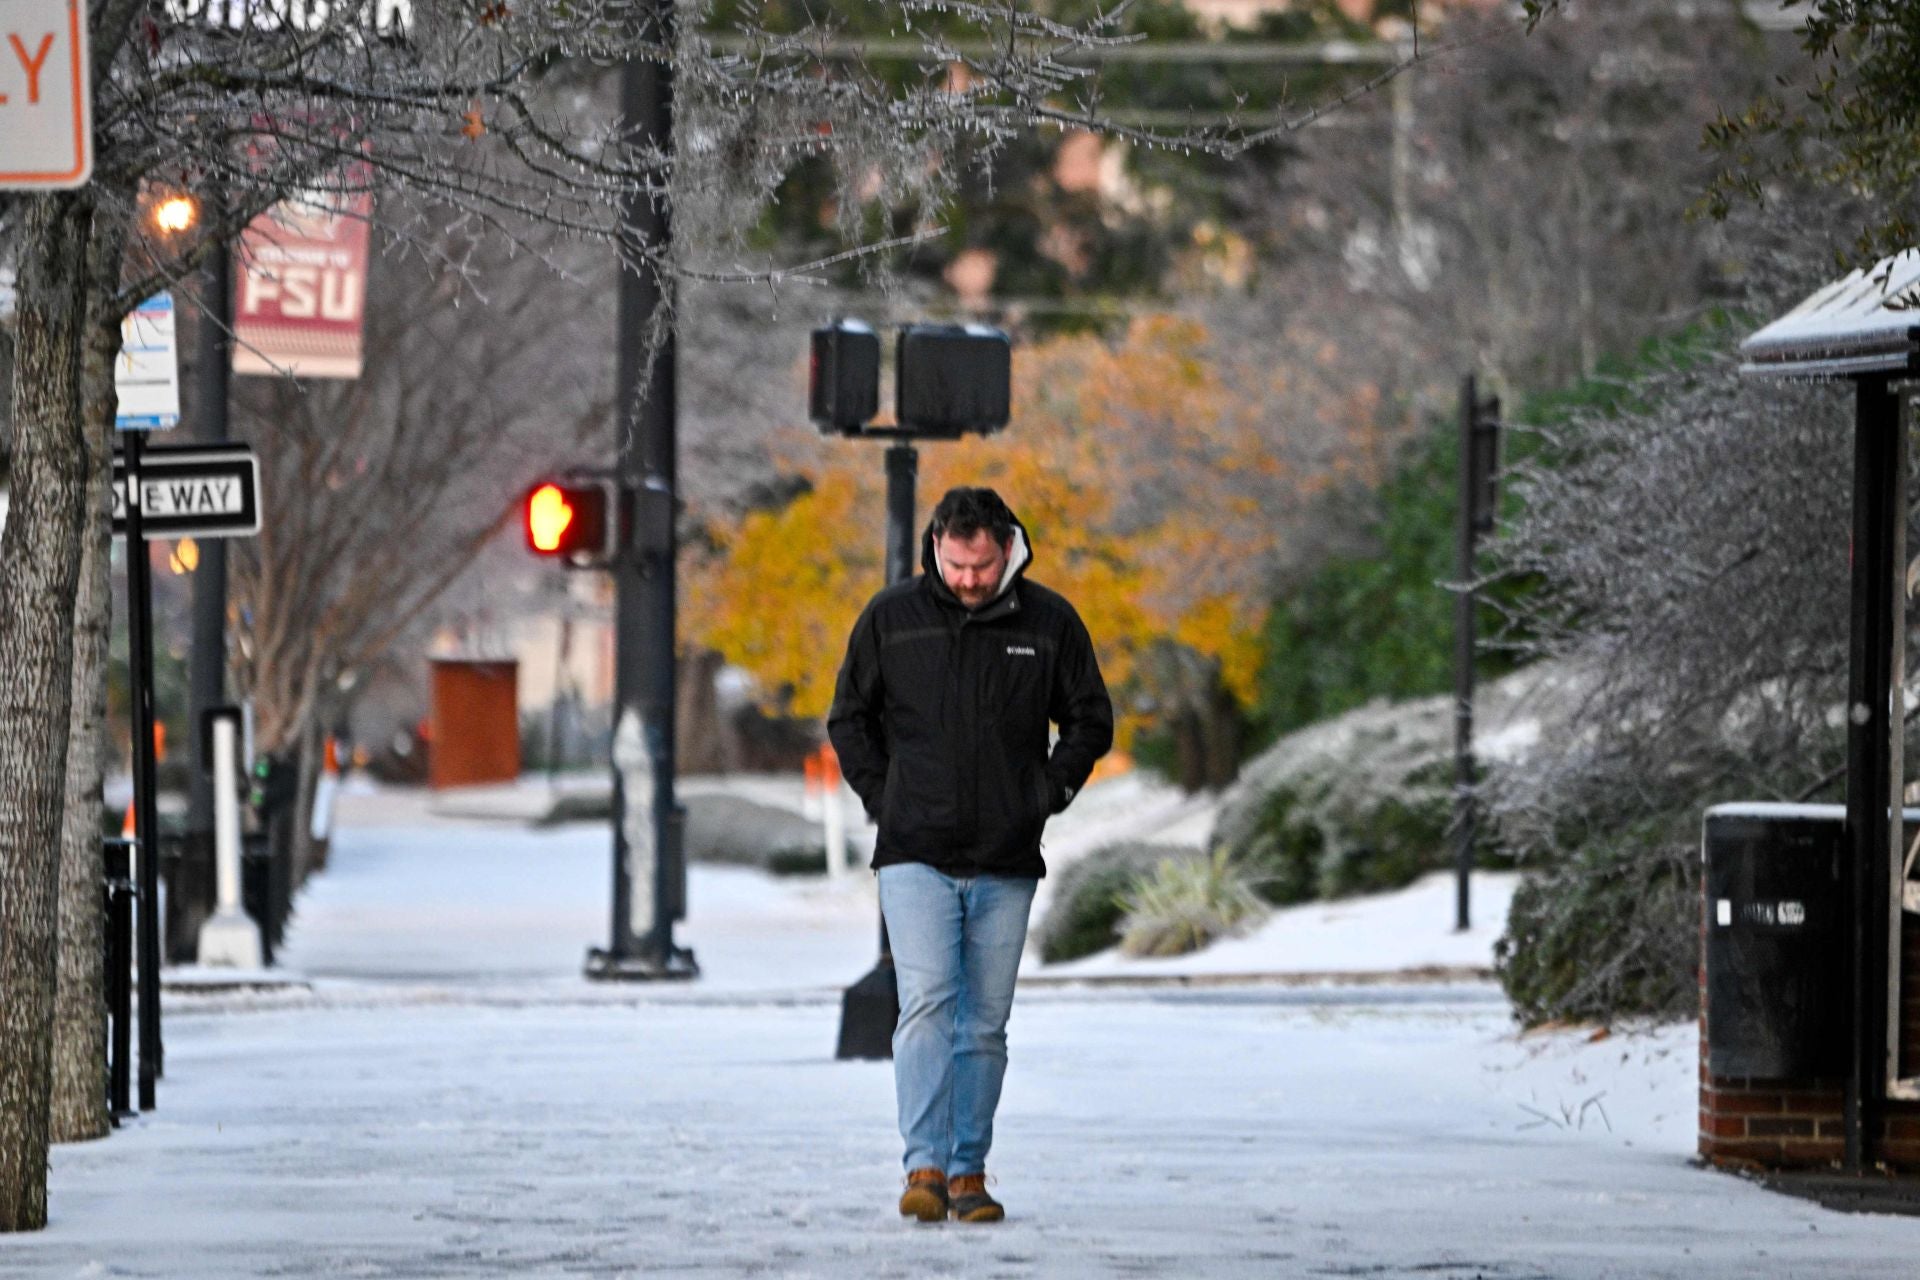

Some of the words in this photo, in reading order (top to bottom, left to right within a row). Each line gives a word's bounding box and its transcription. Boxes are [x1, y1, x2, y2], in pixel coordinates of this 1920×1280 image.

[0, 31, 55, 105] Y
[244, 264, 358, 321] FSU
[170, 479, 230, 512] WAY
